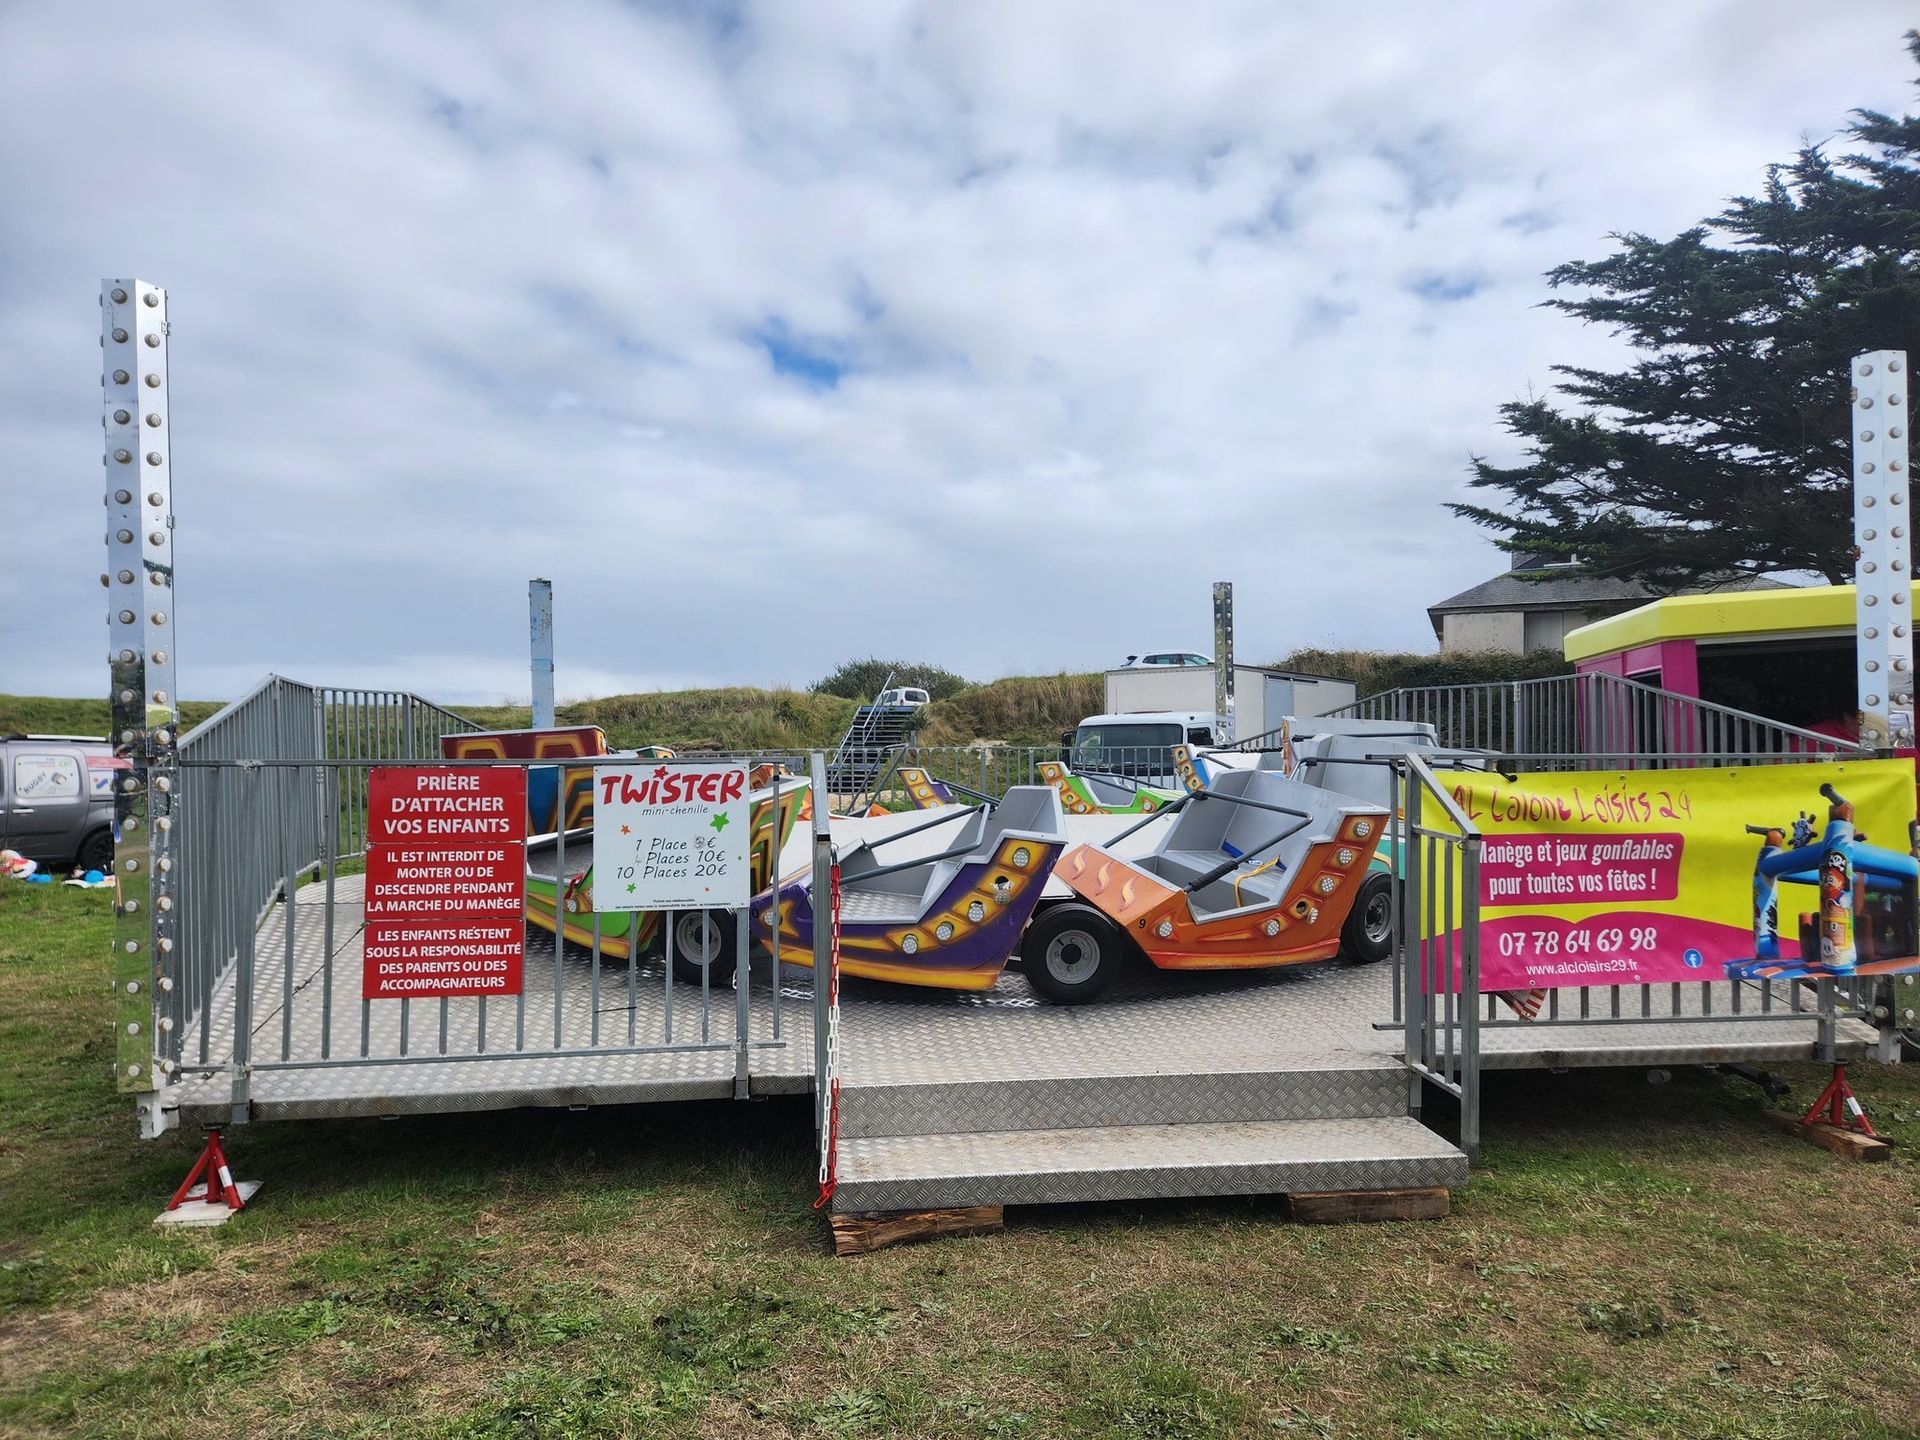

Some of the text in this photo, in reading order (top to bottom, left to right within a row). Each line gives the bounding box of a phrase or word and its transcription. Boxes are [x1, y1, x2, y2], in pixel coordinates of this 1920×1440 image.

[416, 773, 480, 791] PRIÈRE
[600, 766, 745, 805] TWISTER
[391, 797, 504, 813] D'ATTACHER
[641, 804, 709, 816] mini-chenille
[1573, 784, 1651, 824] Loisirs
[383, 818, 510, 834] VOS ENFANTS
[635, 839, 642, 852] 1
[651, 837, 688, 851] Place
[387, 850, 504, 862] IL EST INTERDIT DE
[646, 851, 690, 865] Places
[698, 850, 726, 863] 10€
[1537, 840, 1553, 862] et
[1555, 839, 1588, 867] jeux
[1591, 839, 1674, 866] gonflables
[397, 866, 494, 879] MONTER OU DE
[617, 864, 728, 880] 10 Places 20€
[374, 882, 515, 896] DESCENDRE PENDANT
[1489, 877, 1522, 901] pour
[1526, 872, 1575, 894] toutes
[1578, 874, 1604, 893] vos
[1606, 869, 1647, 892] fêtes
[366, 896, 521, 912] LA MARCHE DU MANÈGE
[1138, 918, 1147, 929] 9
[377, 931, 399, 942] LES
[401, 929, 457, 941] ENFANTS
[1500, 927, 1657, 956] 07 78 64 69 98
[366, 942, 522, 958] SOUS LA RESPONSABILITÉ
[379, 960, 507, 974] DES PARENTS OU DES
[1525, 958, 1638, 976] www.alcloisirs29.fr
[379, 976, 505, 991] ACCOMPAGNATEURS
